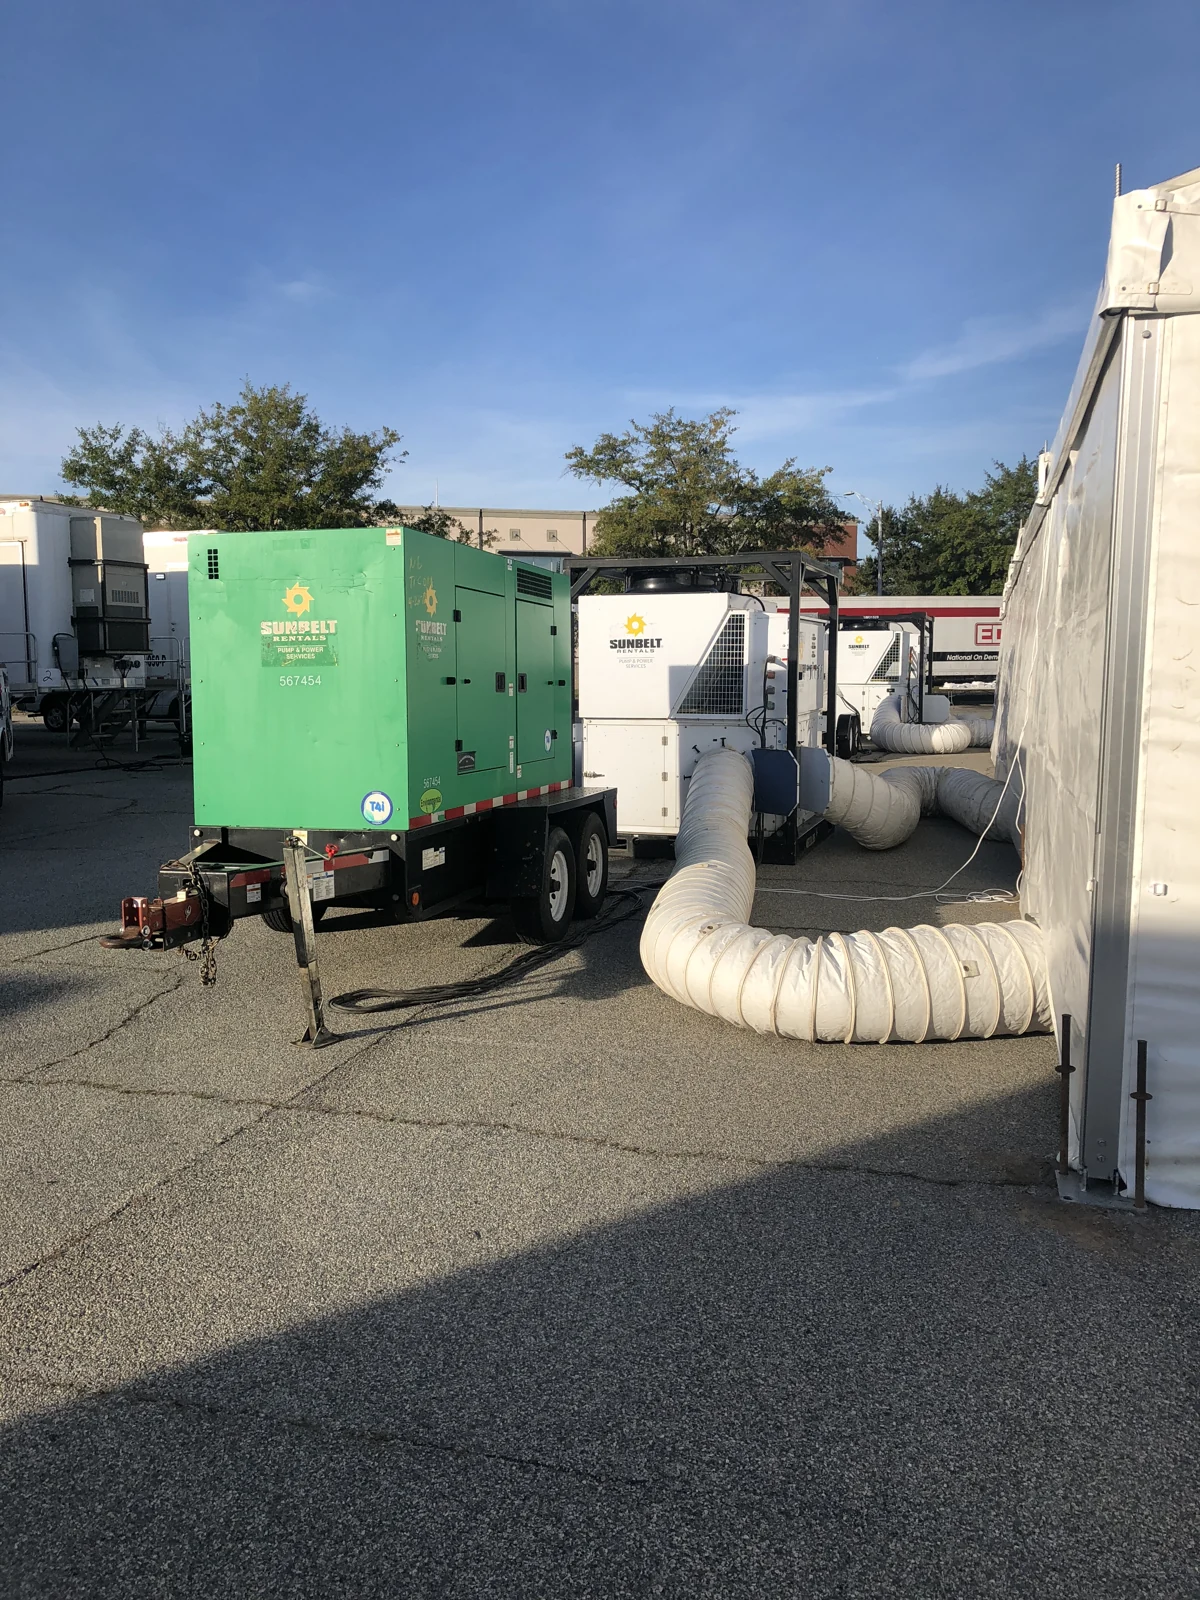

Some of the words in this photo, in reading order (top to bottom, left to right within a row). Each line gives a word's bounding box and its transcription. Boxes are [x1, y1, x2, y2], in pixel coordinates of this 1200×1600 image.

[260, 620, 338, 635] SUNBELT
[609, 638, 663, 649] SUNBELT
[42, 669, 53, 682] 2
[279, 675, 322, 687] 567454
[423, 776, 441, 789] 567454
[369, 800, 386, 813] T4i
